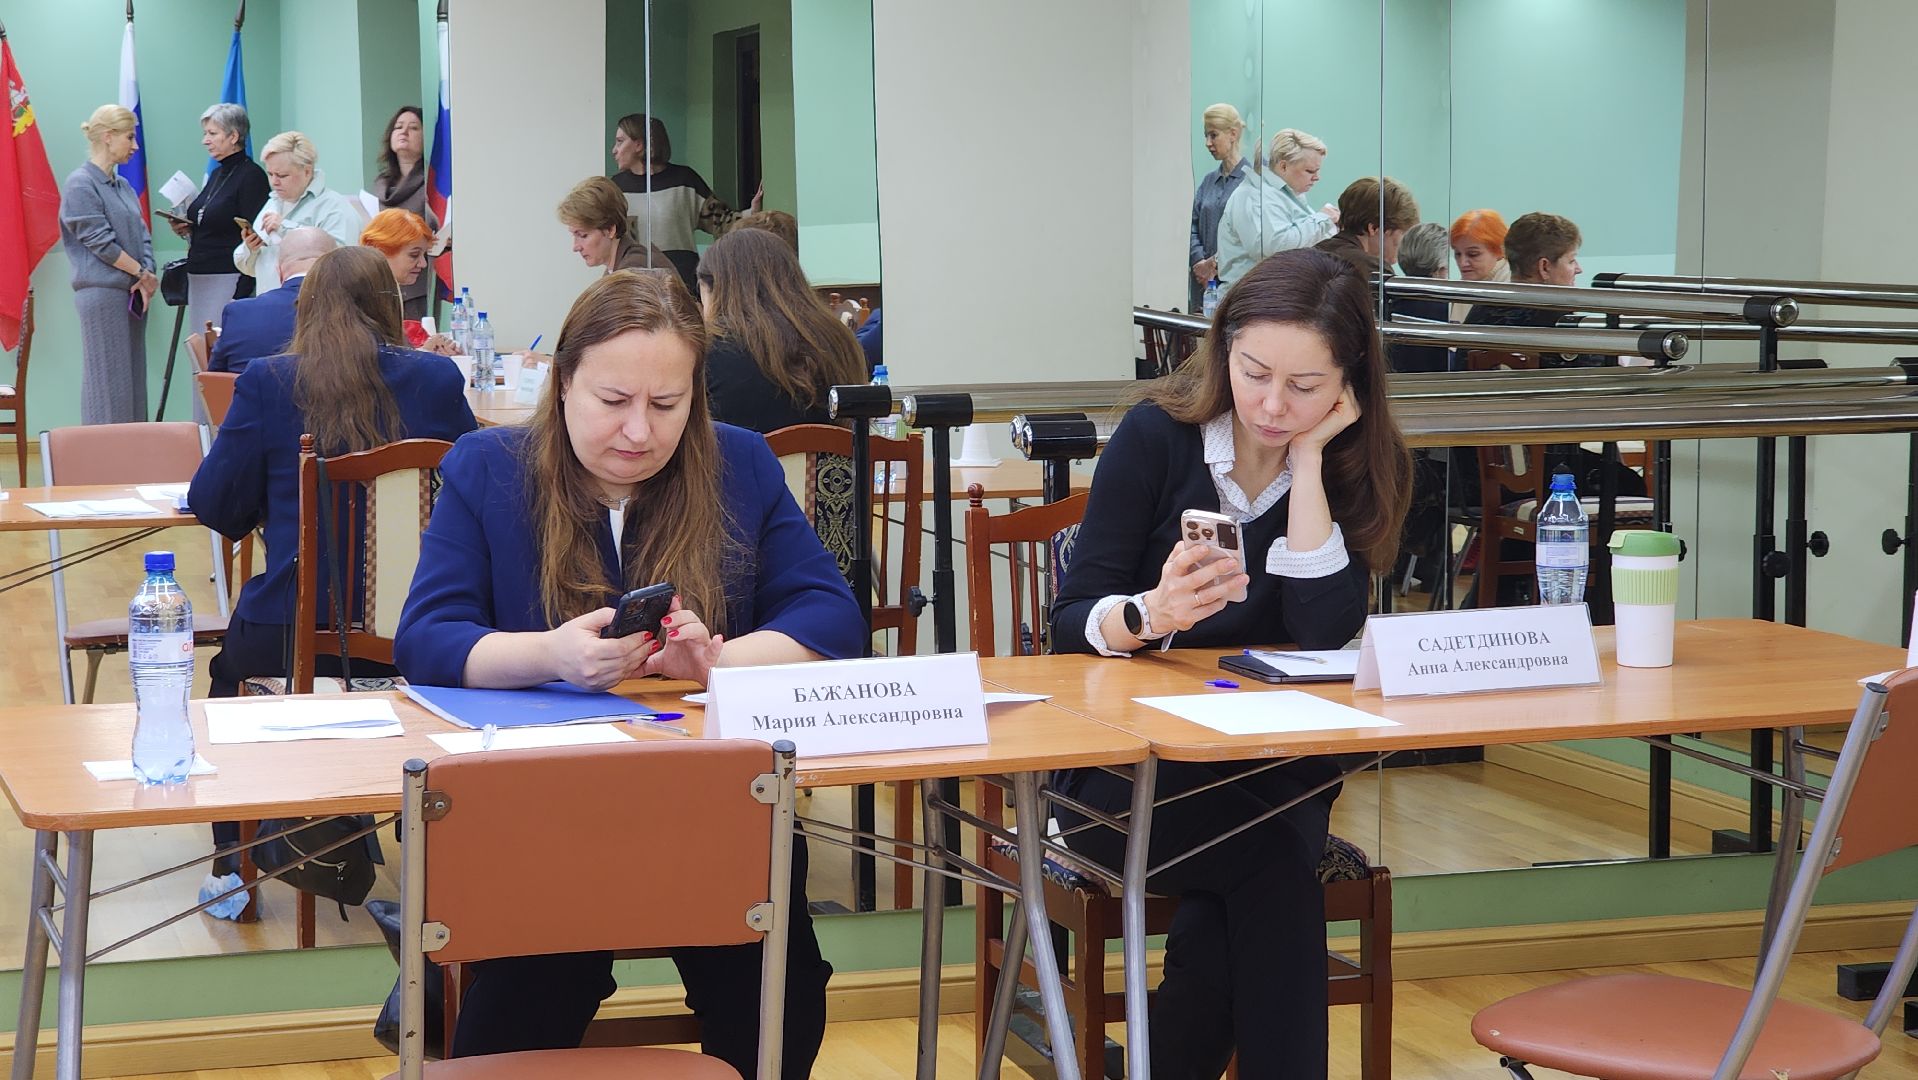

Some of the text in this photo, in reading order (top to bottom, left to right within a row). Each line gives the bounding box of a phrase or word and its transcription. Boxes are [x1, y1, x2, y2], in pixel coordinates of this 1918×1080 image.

[1418, 631, 1551, 653] САДЕТДИНОВА
[1408, 655, 1569, 677] Анна Александровна
[793, 681, 917, 703] БАЖАНОВА
[752, 707, 964, 733] Мария Александровна
